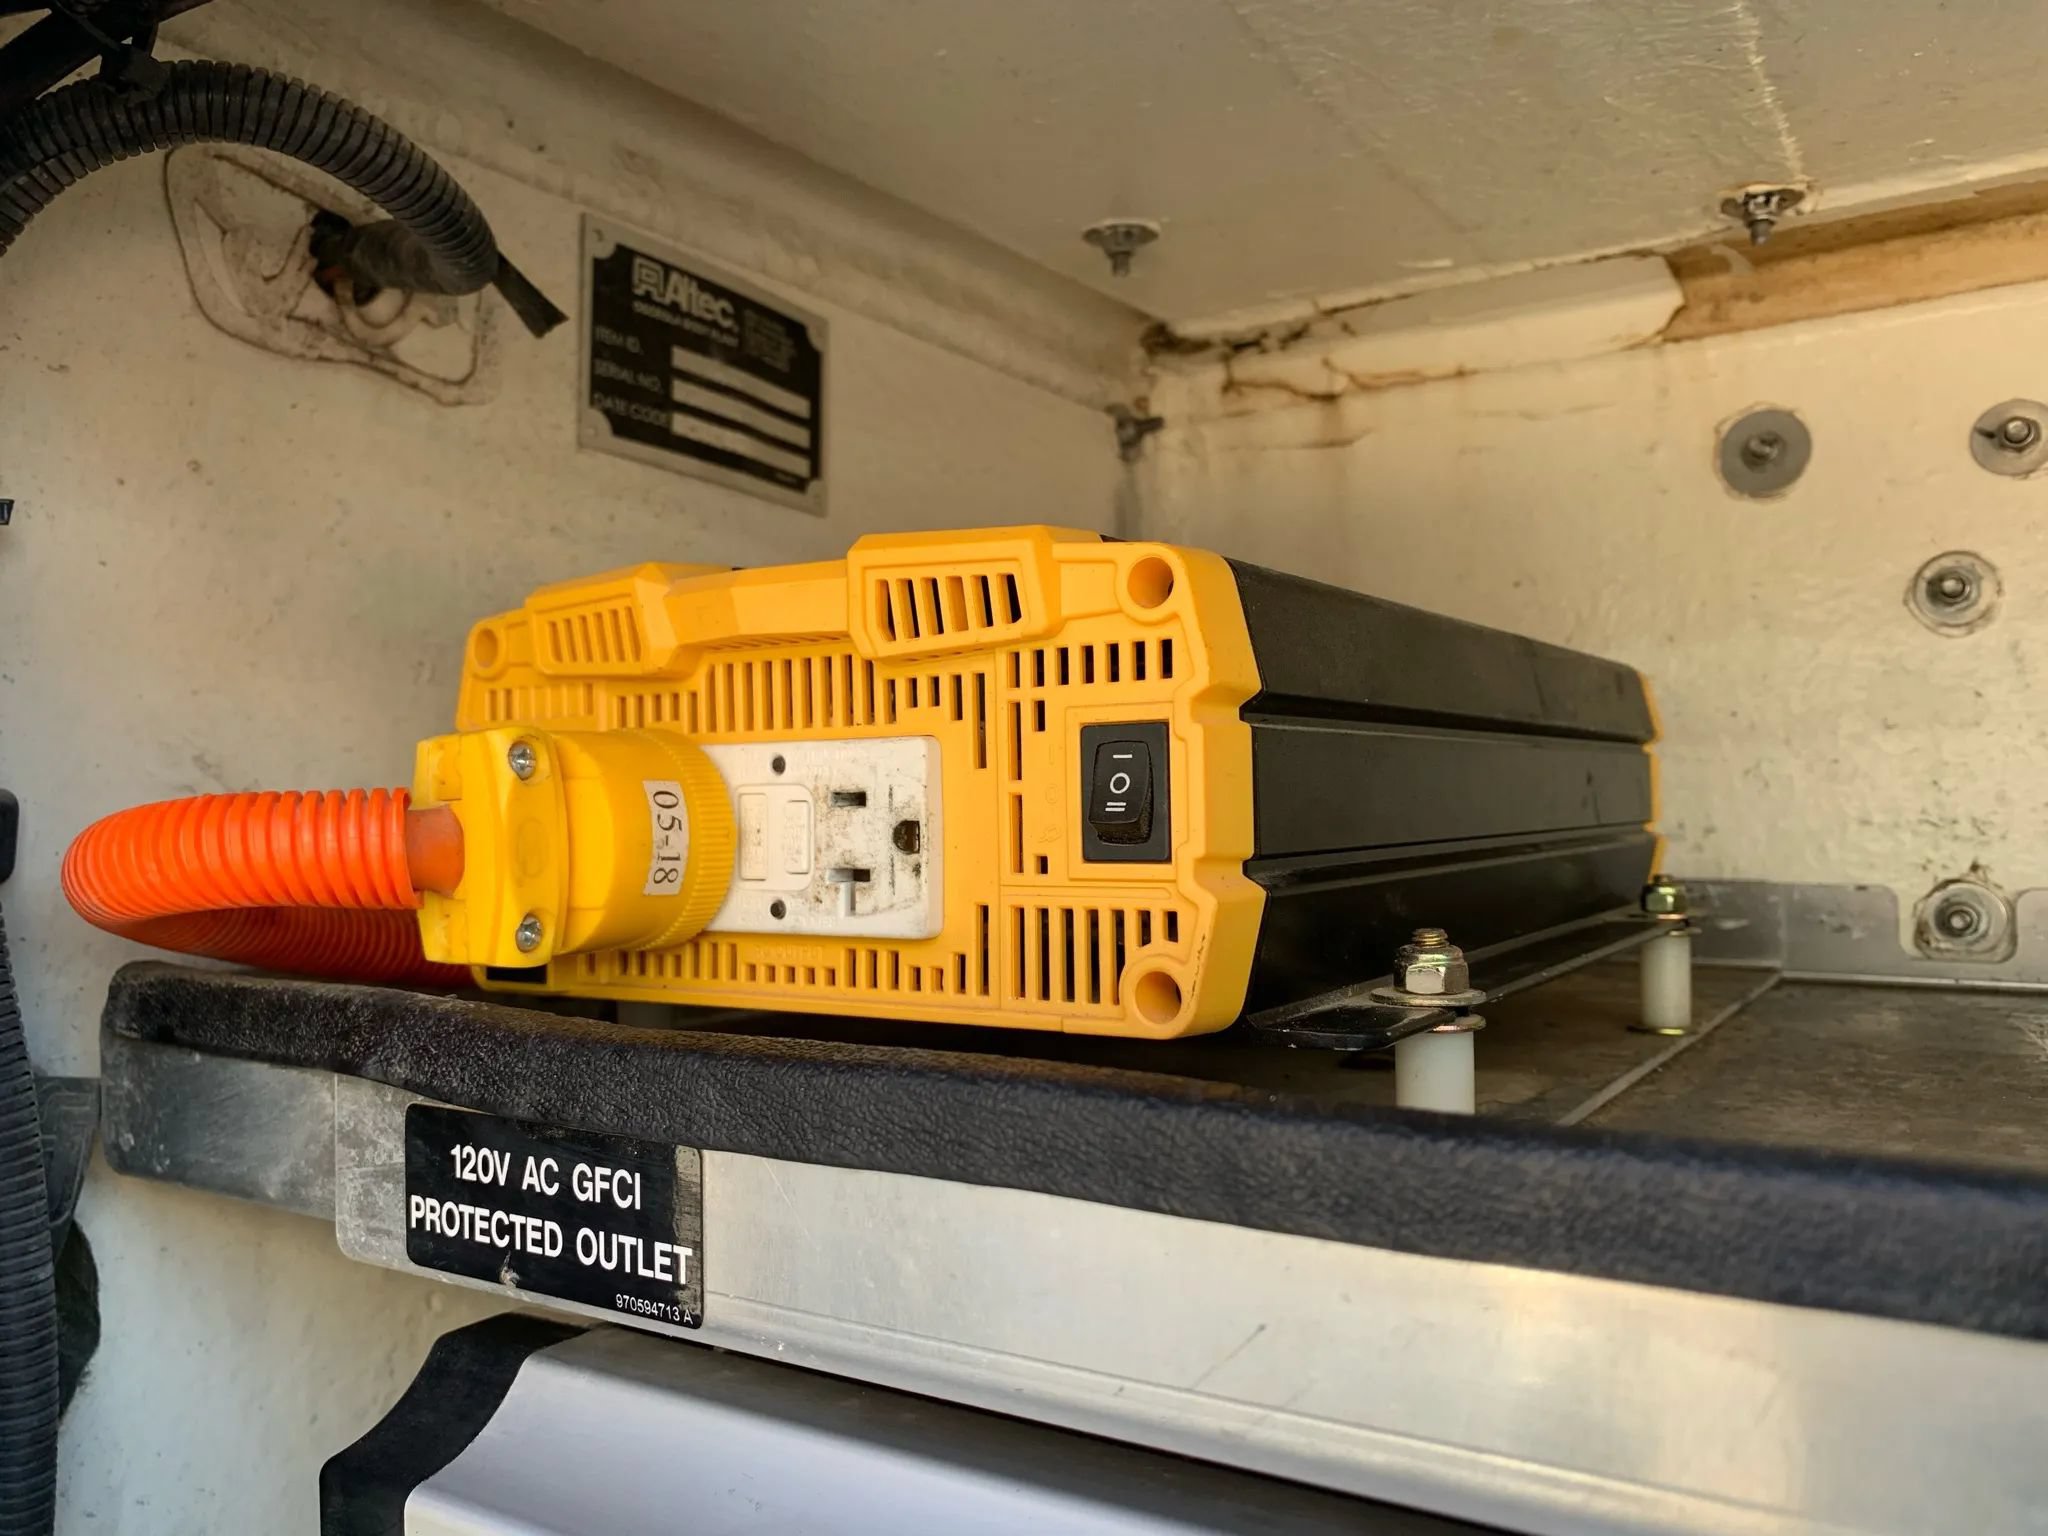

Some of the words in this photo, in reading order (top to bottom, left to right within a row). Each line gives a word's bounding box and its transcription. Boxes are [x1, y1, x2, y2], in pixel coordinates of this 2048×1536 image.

[665, 271, 735, 329] Altec
[593, 391, 629, 416] DATE
[653, 790, 682, 884] 05-18
[450, 1143, 511, 1186] 120V
[522, 1155, 559, 1196] AC
[572, 1163, 641, 1210] GFCI
[410, 1194, 563, 1258] PROTECTED
[576, 1227, 693, 1285] OUTLET
[615, 1293, 680, 1321] 970594713
[683, 1309, 694, 1325] A
